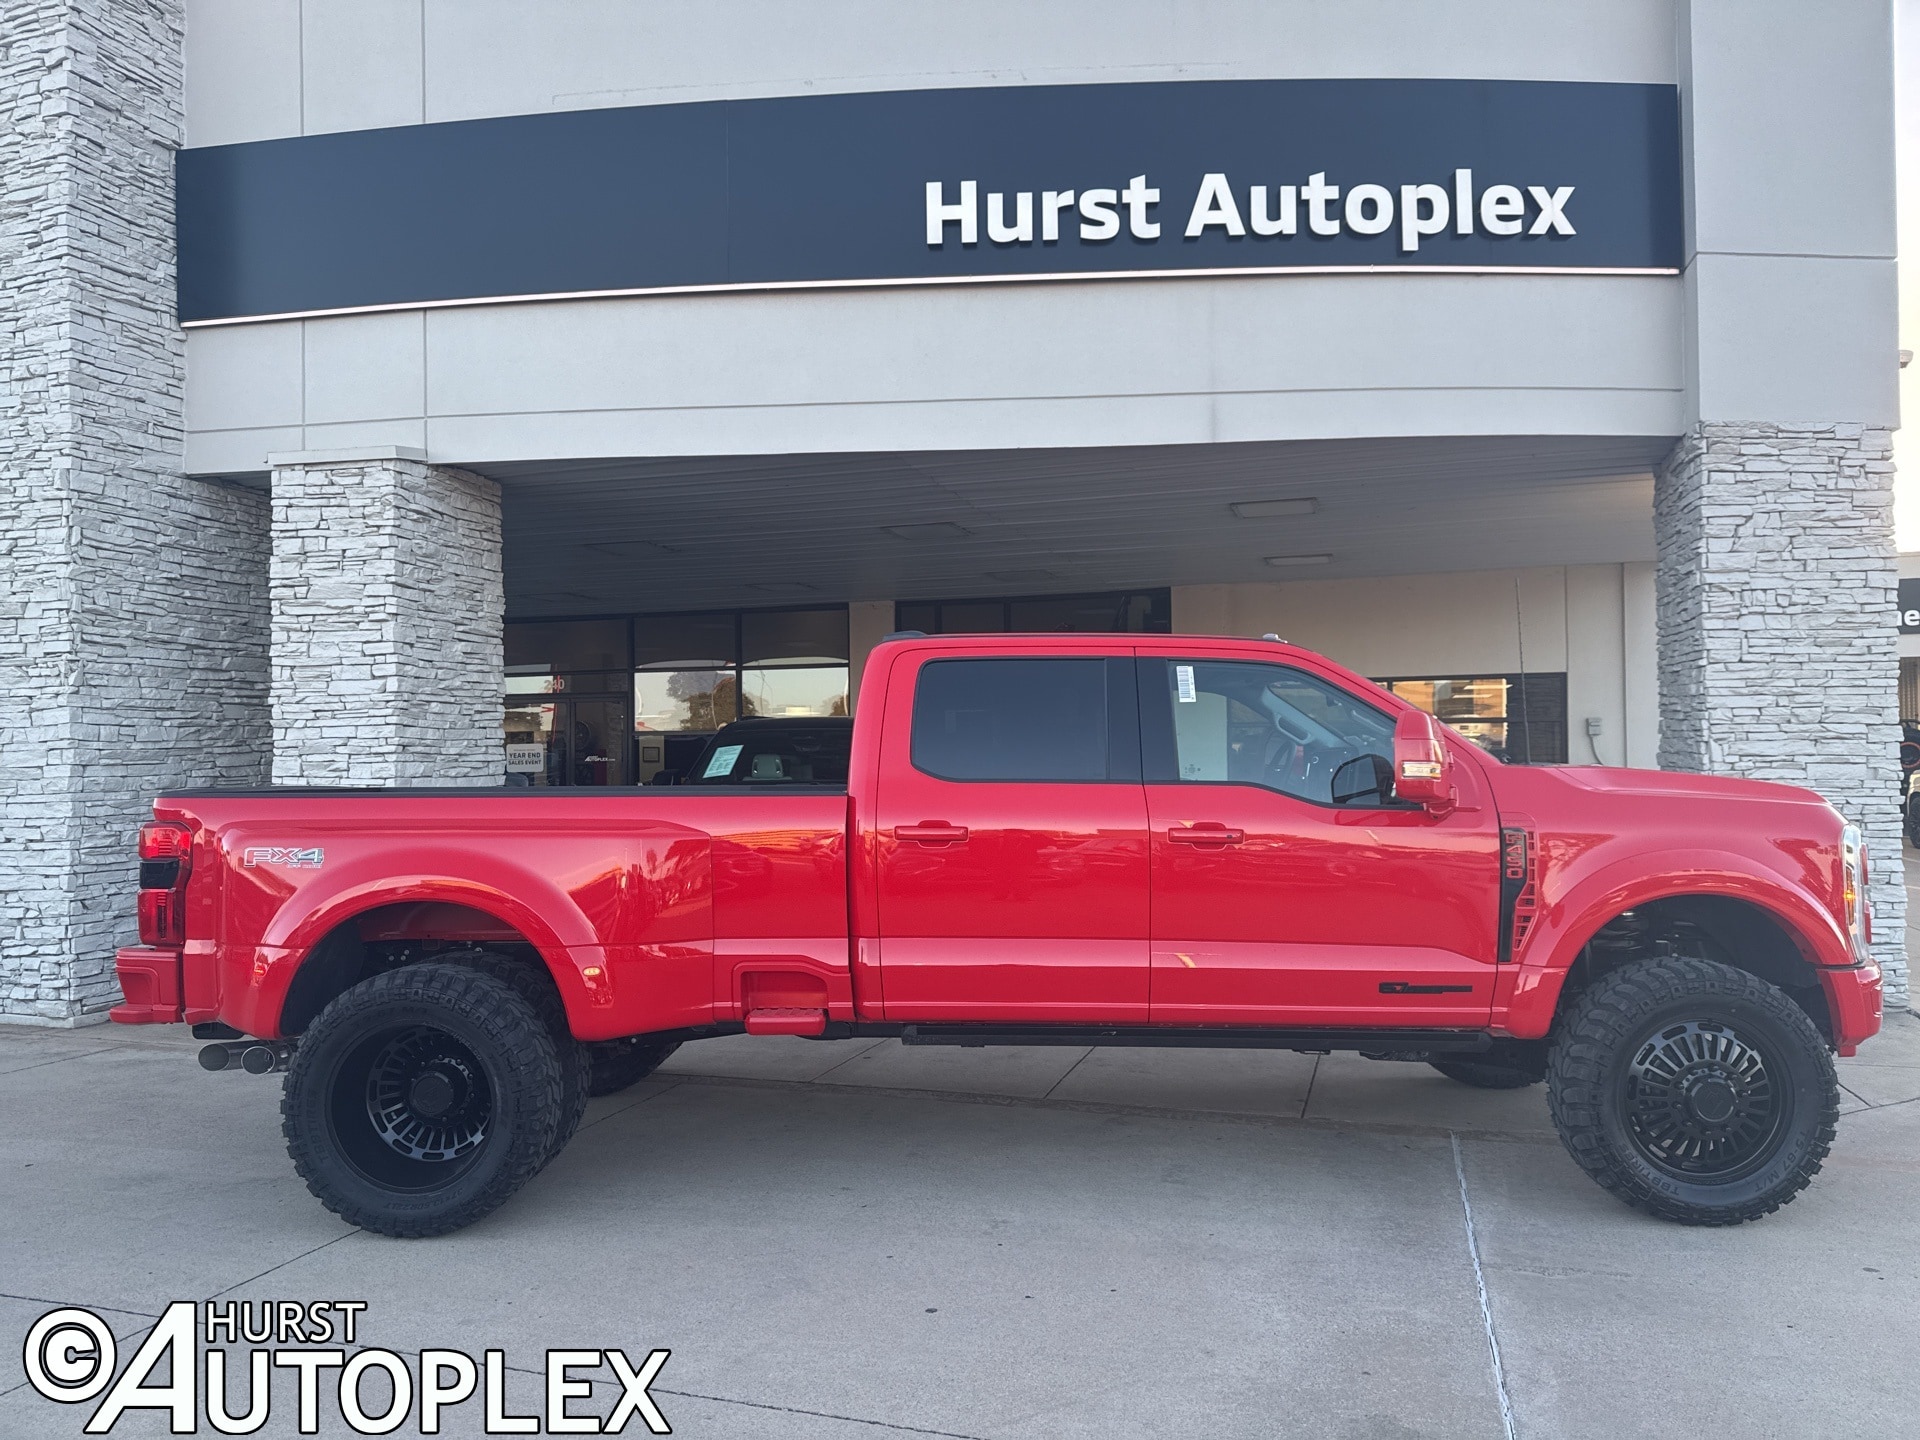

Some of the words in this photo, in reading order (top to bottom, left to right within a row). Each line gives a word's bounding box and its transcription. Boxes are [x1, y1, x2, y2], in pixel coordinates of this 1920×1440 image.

[925, 174, 1162, 246] Hurst
[1184, 168, 1577, 252] Autoplex
[543, 679, 566, 690] 240
[244, 847, 324, 867] FX4
